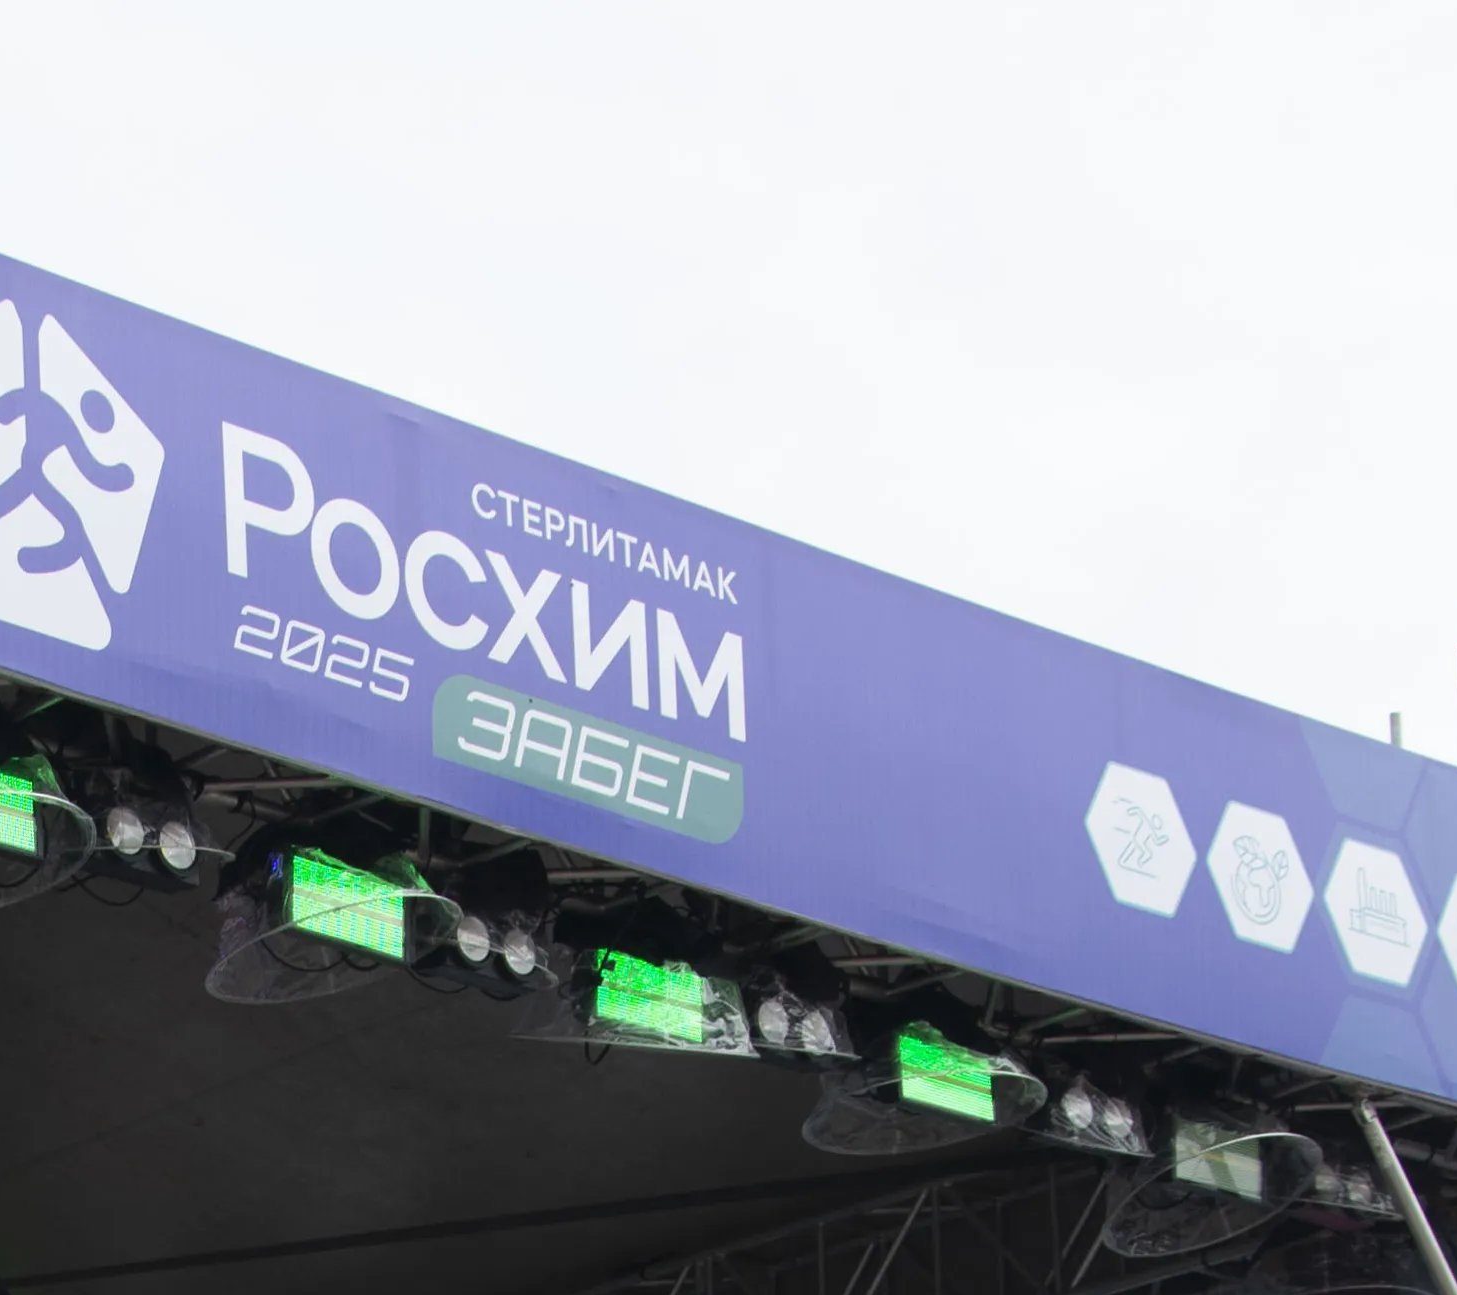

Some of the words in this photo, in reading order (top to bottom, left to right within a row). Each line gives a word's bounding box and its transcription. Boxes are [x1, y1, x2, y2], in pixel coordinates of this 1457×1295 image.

[470, 481, 739, 604] СТЕРЛИТАМАК
[233, 604, 415, 702] 2025
[456, 690, 731, 820] ЗАБЕГ
